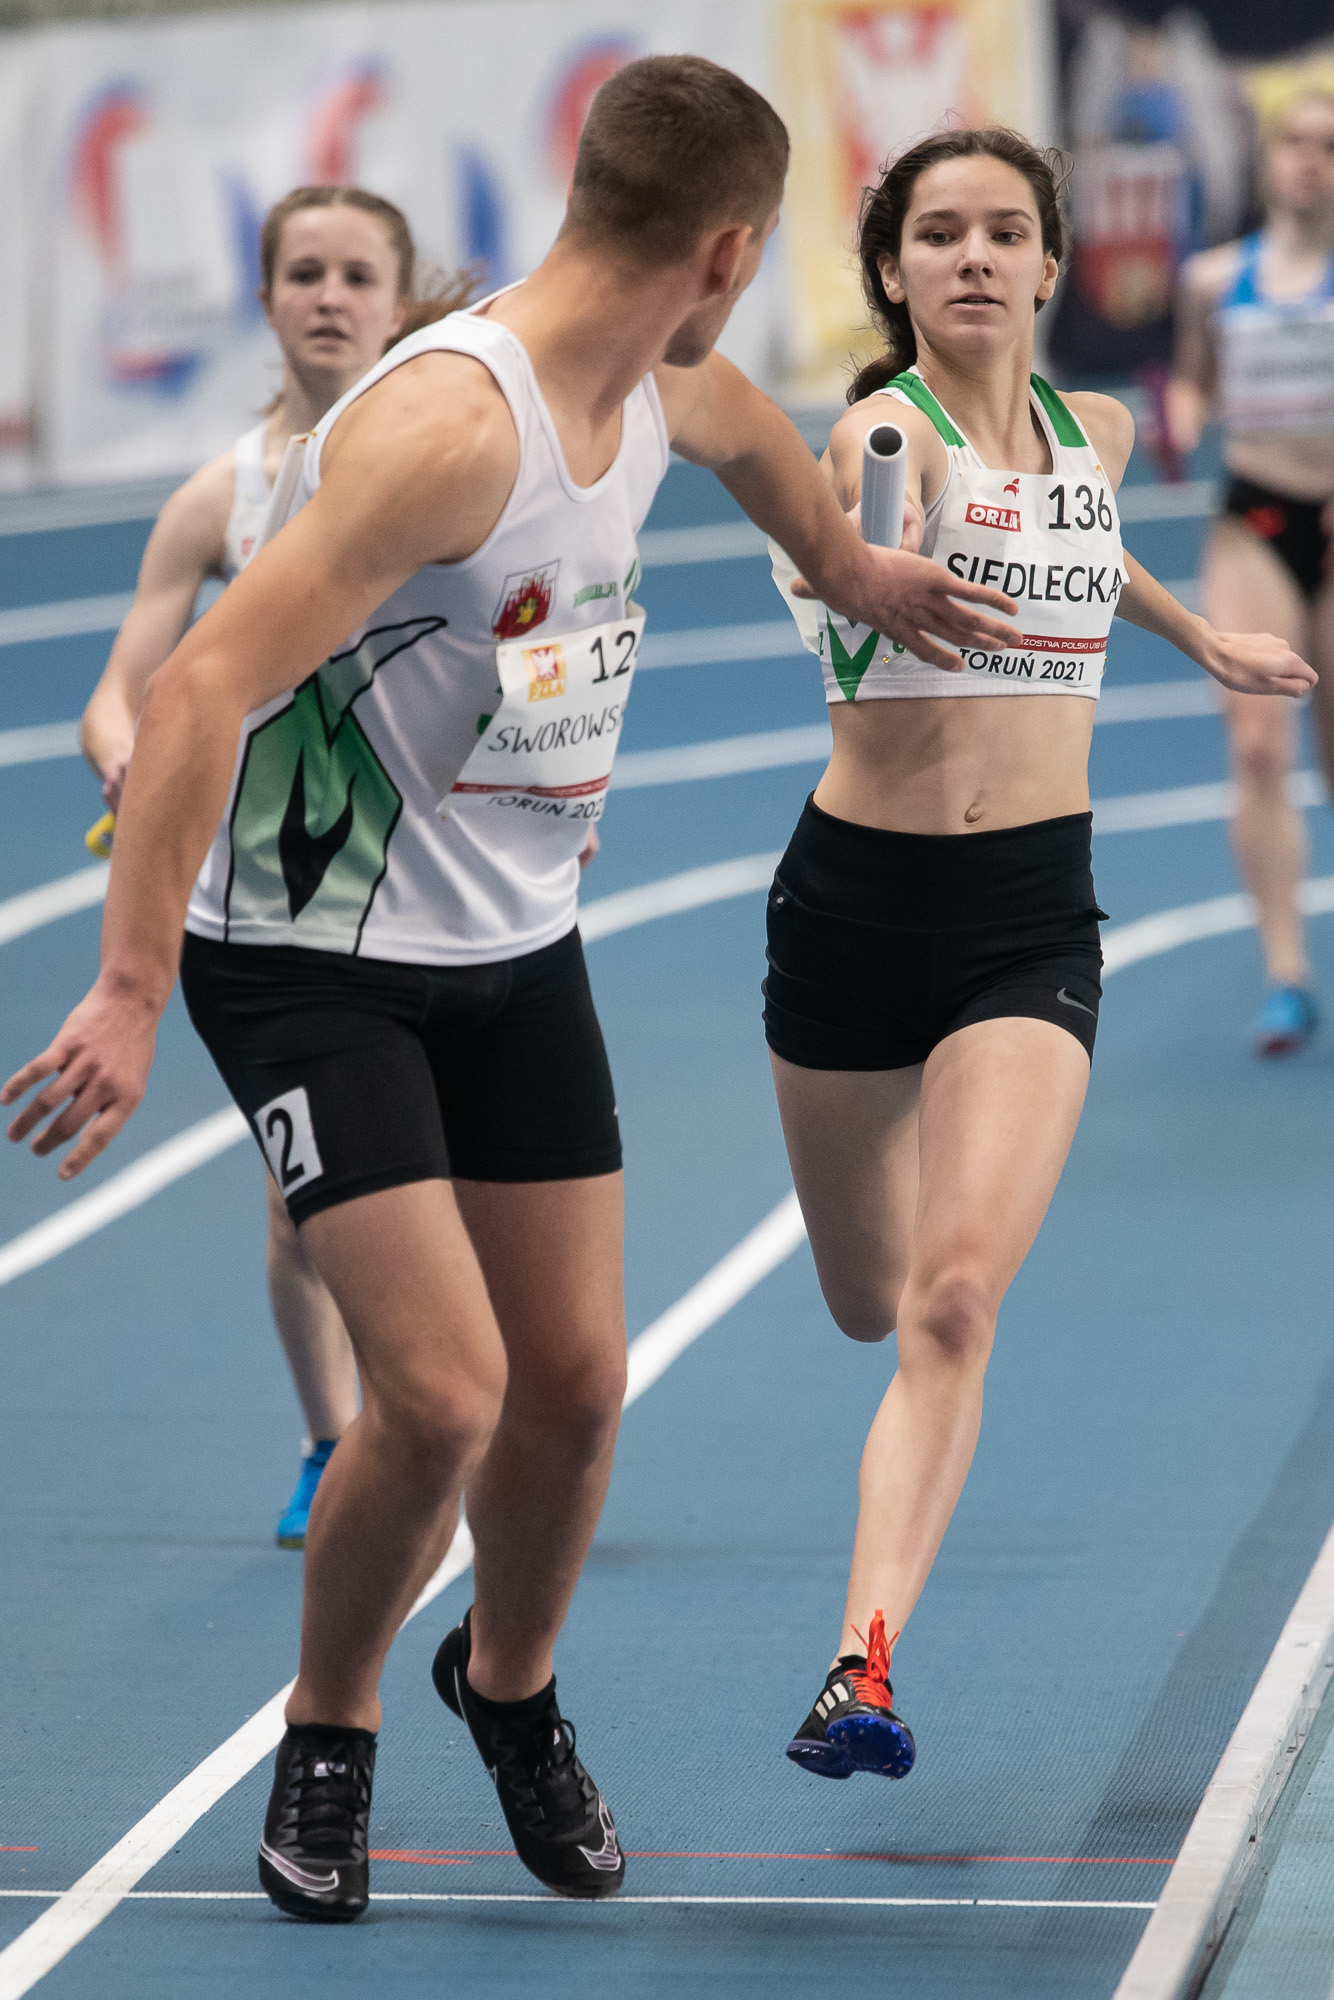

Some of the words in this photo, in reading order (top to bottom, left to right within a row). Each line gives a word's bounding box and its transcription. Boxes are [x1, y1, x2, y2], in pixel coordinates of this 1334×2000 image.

[1048, 484, 1113, 532] 136
[947, 552, 1122, 603] SIEDLECKA
[590, 630, 638, 685] 12
[960, 648, 1034, 678] TORUŃ
[1039, 659, 1084, 681] 2021
[1061, 642, 1088, 650] POLSKI
[488, 704, 621, 754] SWOROWS
[266, 1107, 305, 1189] 2
